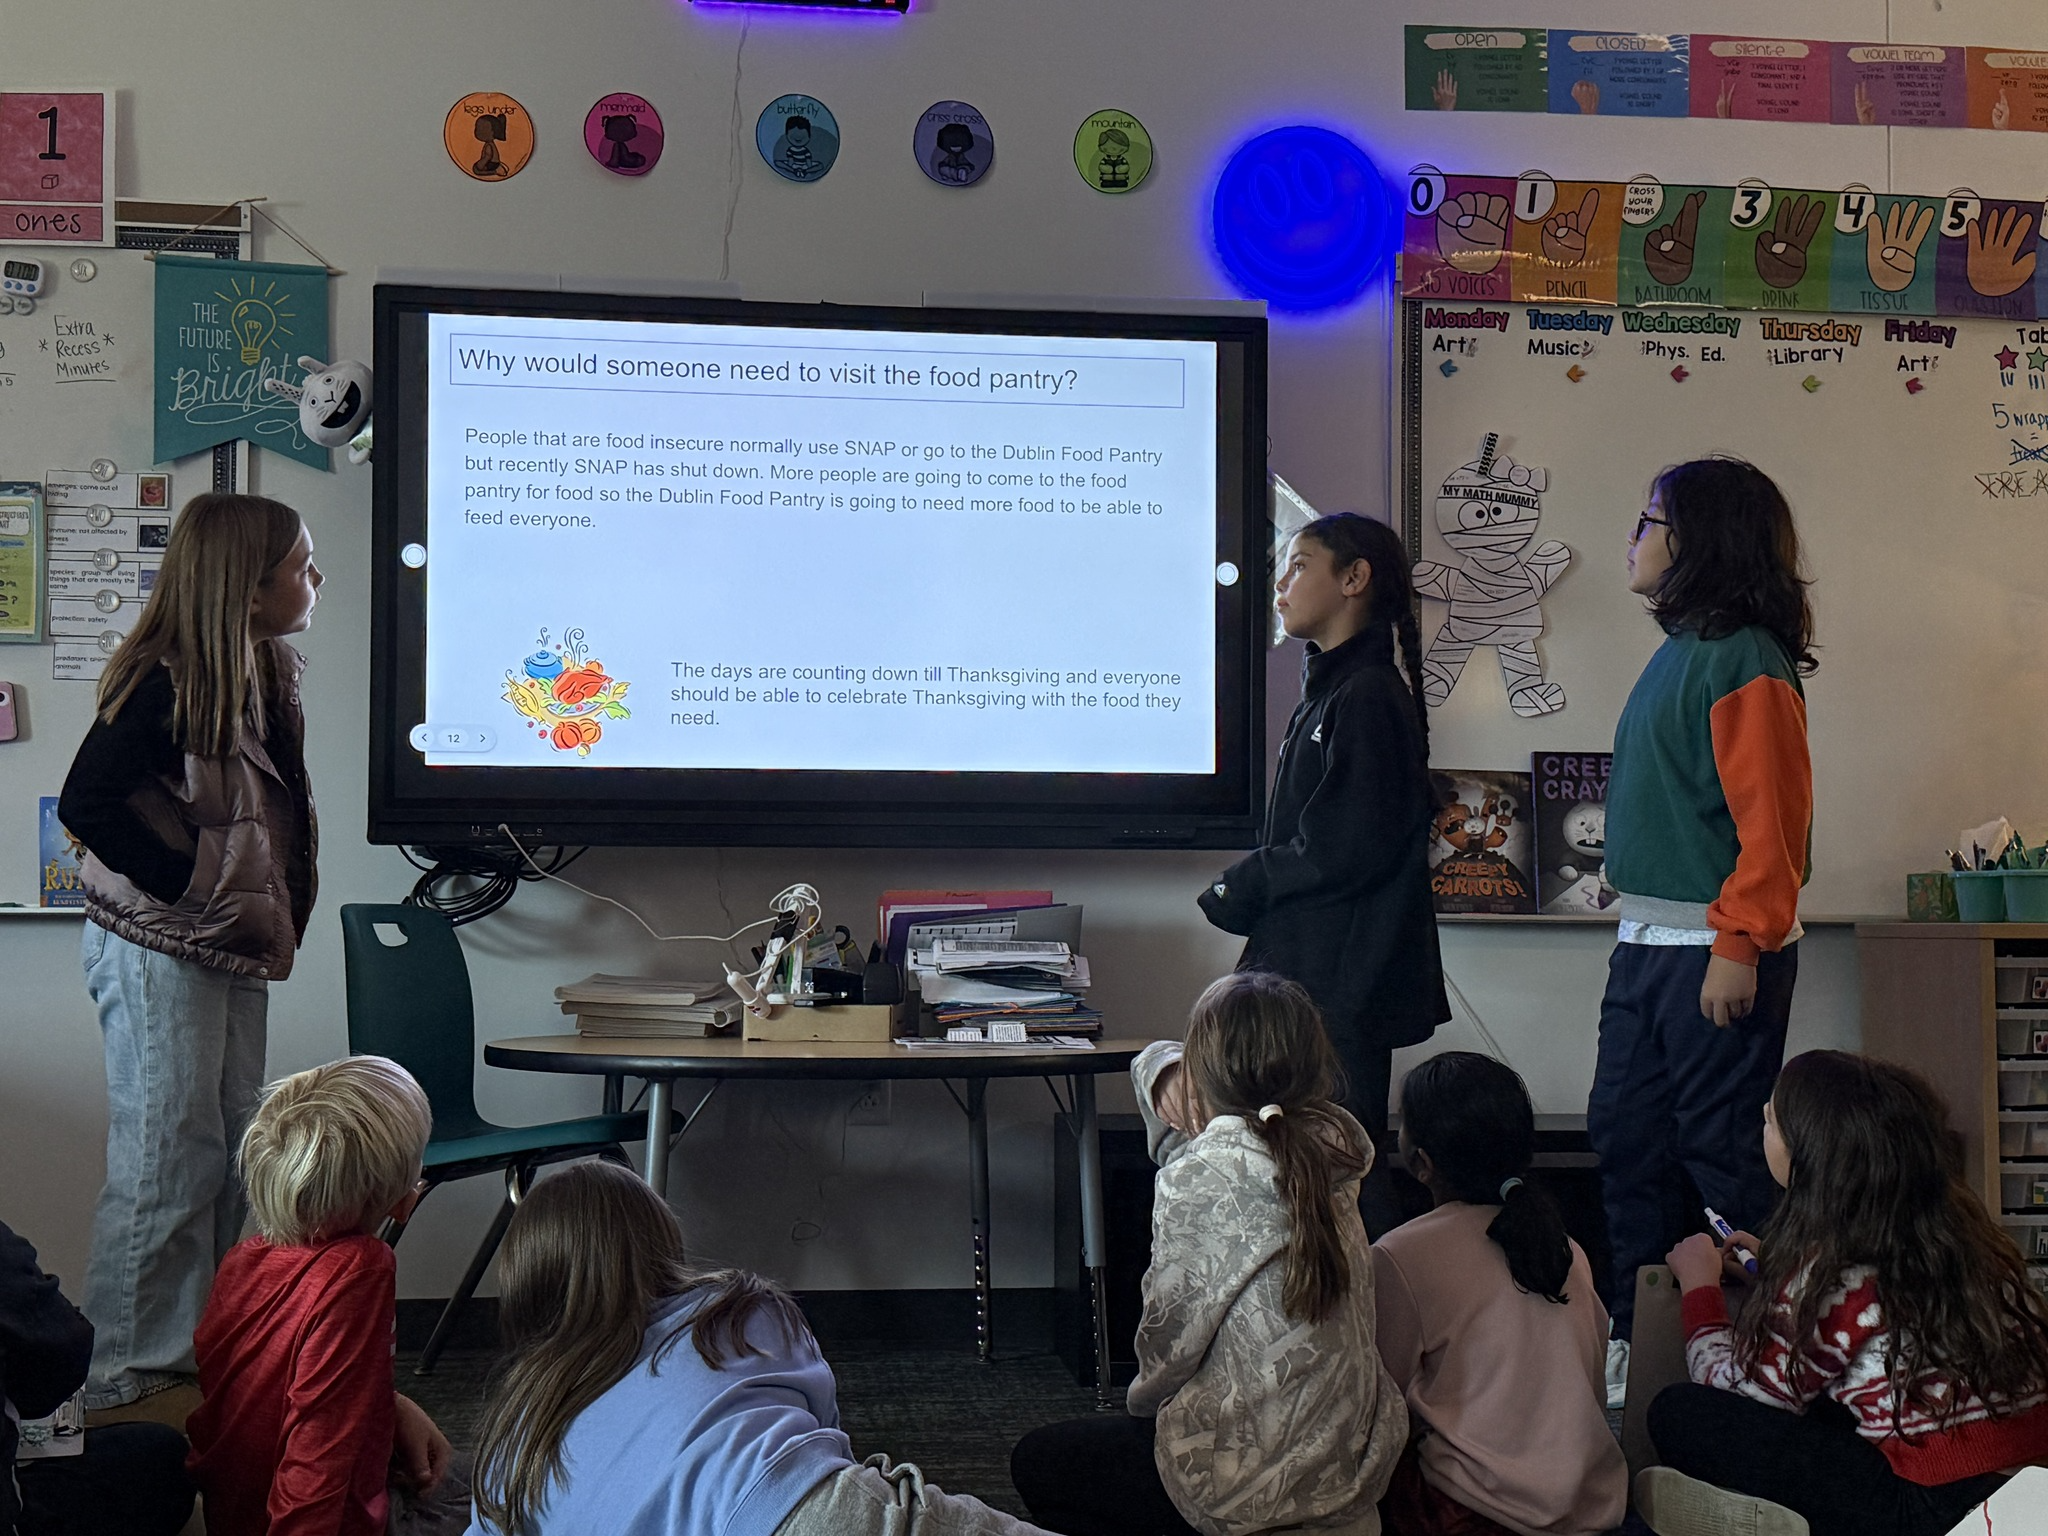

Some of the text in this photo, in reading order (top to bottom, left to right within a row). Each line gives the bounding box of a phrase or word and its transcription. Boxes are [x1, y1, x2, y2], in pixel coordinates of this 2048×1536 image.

[463, 102, 518, 116] legs under
[600, 103, 646, 113] mermaid
[777, 102, 820, 117] butterfly
[927, 112, 982, 125] criss cross
[36, 106, 66, 160] 1
[1091, 118, 1137, 129] mountain
[1410, 177, 1433, 212] 0
[1628, 186, 1656, 195] CROSS
[1628, 197, 1653, 206] YOUR
[1623, 206, 1655, 216] FINGERS
[1733, 189, 1763, 224] 3
[1843, 194, 1866, 228] 4
[1947, 200, 1969, 230] 5
[15, 211, 82, 234] ones
[1447, 275, 1498, 296] VOICES
[1545, 280, 1588, 298] PENCIL
[1635, 286, 1712, 304] BATHROOM
[1762, 290, 1800, 308] DRINK
[1860, 290, 1909, 311] TISSUE
[1954, 294, 2024, 315] QUESTION
[193, 302, 220, 324] THE
[1424, 307, 1509, 333] Monday
[1526, 309, 1614, 336] Tuesday
[54, 314, 95, 336] Extra
[1622, 311, 1742, 338] Wednesday
[1760, 317, 1863, 346] Thursday
[1884, 319, 1957, 348] Friday
[56, 338, 101, 359] Recess
[179, 326, 233, 350] FUTURE
[1432, 335, 1466, 353] Art
[1527, 338, 1580, 356] Music
[208, 353, 220, 373] IS
[1645, 341, 1726, 363] Phys. Ed.
[1773, 347, 1845, 365] Library
[56, 360, 110, 378] Minutes
[458, 348, 1078, 395] Why would someone need to visit the food pantry?
[1897, 354, 1929, 373] Art
[168, 352, 296, 412] Bright
[1991, 402, 2010, 429] 5
[466, 428, 1162, 467] People that are food insecure normally use SNAP or go to the Dublin Food Pantry
[465, 455, 1126, 488] but recently SNAP has shut down. More people are going to come to the food
[465, 484, 1162, 515] pantry for food so the Dublin Food Pantry is going to need more food to be able to
[1443, 485, 1539, 508] MY MATH MUMMY
[464, 509, 596, 530] feed everyone.
[670, 662, 1181, 689] The days are counting down till Thanksgiving and everyone
[671, 686, 1182, 712] should be able to celebrate Thanksgiving with the food they
[671, 710, 720, 726] need.
[447, 733, 461, 744] 12
[1542, 755, 1613, 777] CREE
[1542, 780, 1608, 800] CRAY
[44, 865, 83, 891] RU
[1442, 861, 1509, 878] CREEPY
[1431, 876, 1528, 898] CARROTS!
